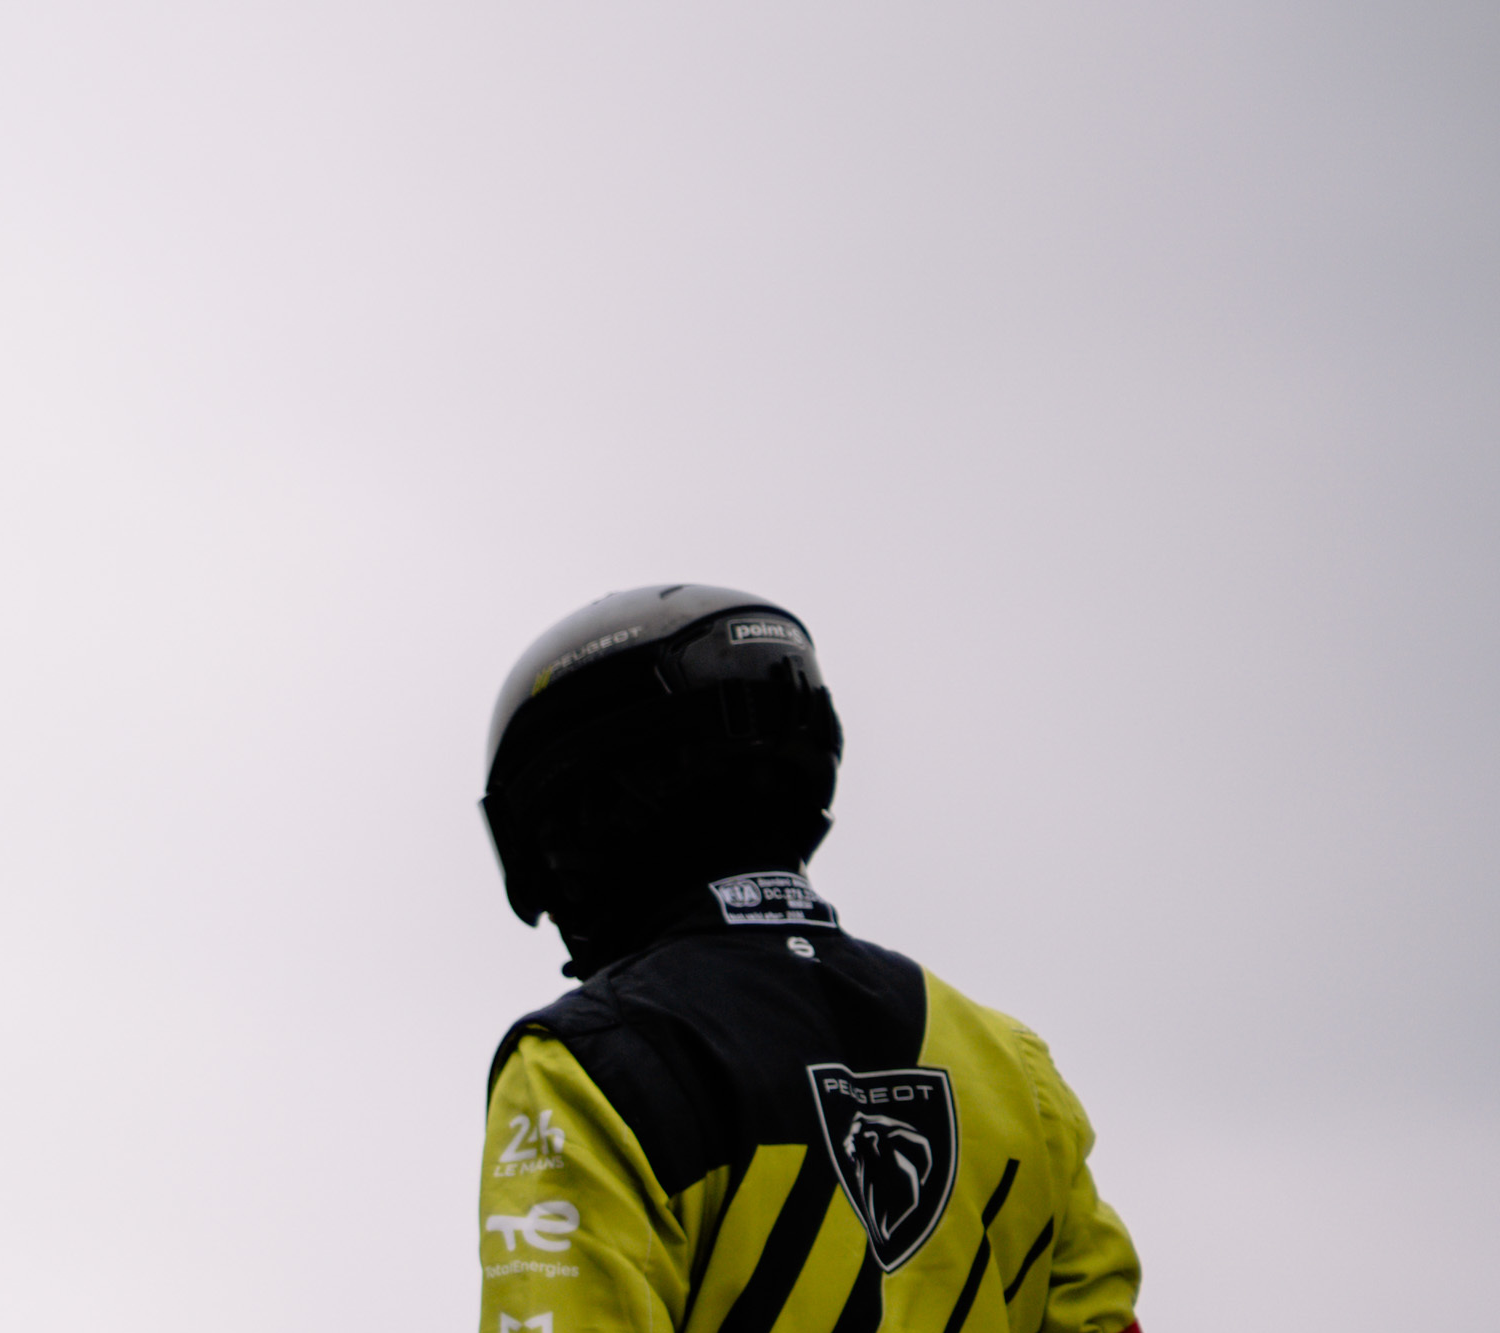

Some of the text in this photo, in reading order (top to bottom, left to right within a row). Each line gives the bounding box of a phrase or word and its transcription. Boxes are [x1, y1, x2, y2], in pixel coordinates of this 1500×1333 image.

[822, 1078, 934, 1104] PEGEOT
[493, 1156, 565, 1178] LE MANS
[485, 1250, 580, 1279] TotalEnergies
